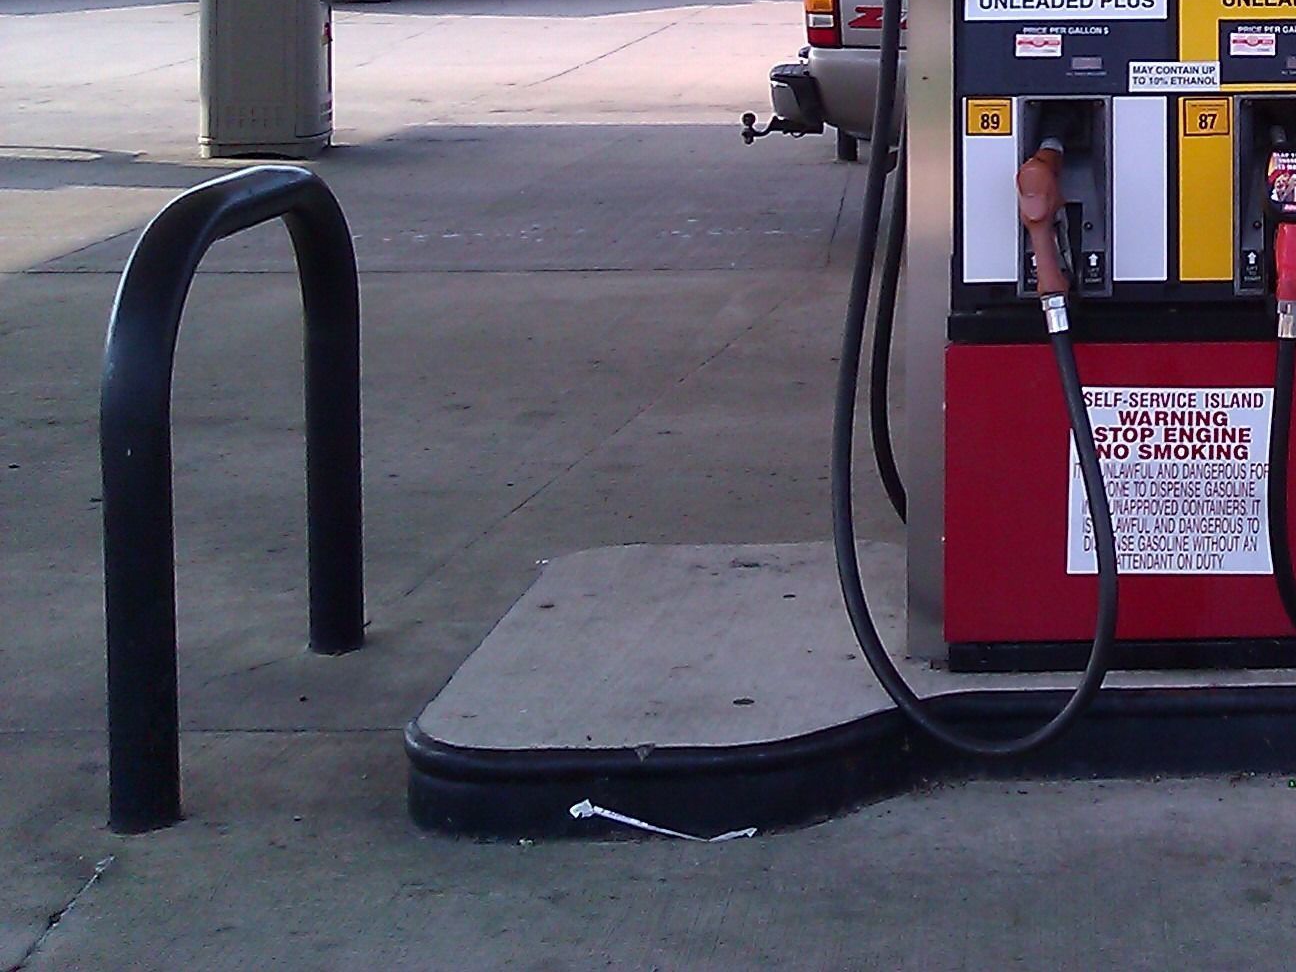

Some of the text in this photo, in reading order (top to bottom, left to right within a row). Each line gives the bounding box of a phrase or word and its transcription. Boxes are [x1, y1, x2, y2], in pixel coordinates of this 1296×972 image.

[1068, 27, 1102, 35] GALLON
[1103, 27, 1109, 35] $
[1133, 66, 1216, 74] MAY CONTAIN UP
[1133, 77, 1218, 85] TO 10% ETHANOL
[980, 113, 1000, 130] 89
[1198, 113, 1218, 130] 87
[1083, 391, 1264, 408] SELF-SERVICE ISLAND
[1118, 410, 1228, 427] WARNING
[1094, 427, 1251, 443] STOP ENGINE
[1096, 444, 1249, 460] NO SMOKING
[1157, 463, 1179, 479] AND
[1182, 463, 1247, 480] DANGEROUS
[1133, 481, 1147, 497] TO
[1150, 481, 1201, 498] DISPENSE
[1204, 481, 1256, 498] GASOLINE
[1252, 499, 1261, 515] IT
[1082, 517, 1092, 534] IS
[1153, 517, 1176, 534] AND
[1179, 517, 1244, 534] DANGEROUS
[1246, 517, 1260, 534] TO
[1137, 535, 1190, 552] GASOLINE
[1192, 535, 1241, 552] WITHOUT
[1243, 535, 1258, 552] AN
[1177, 553, 1193, 569] ON
[1196, 553, 1225, 570] DUTY
